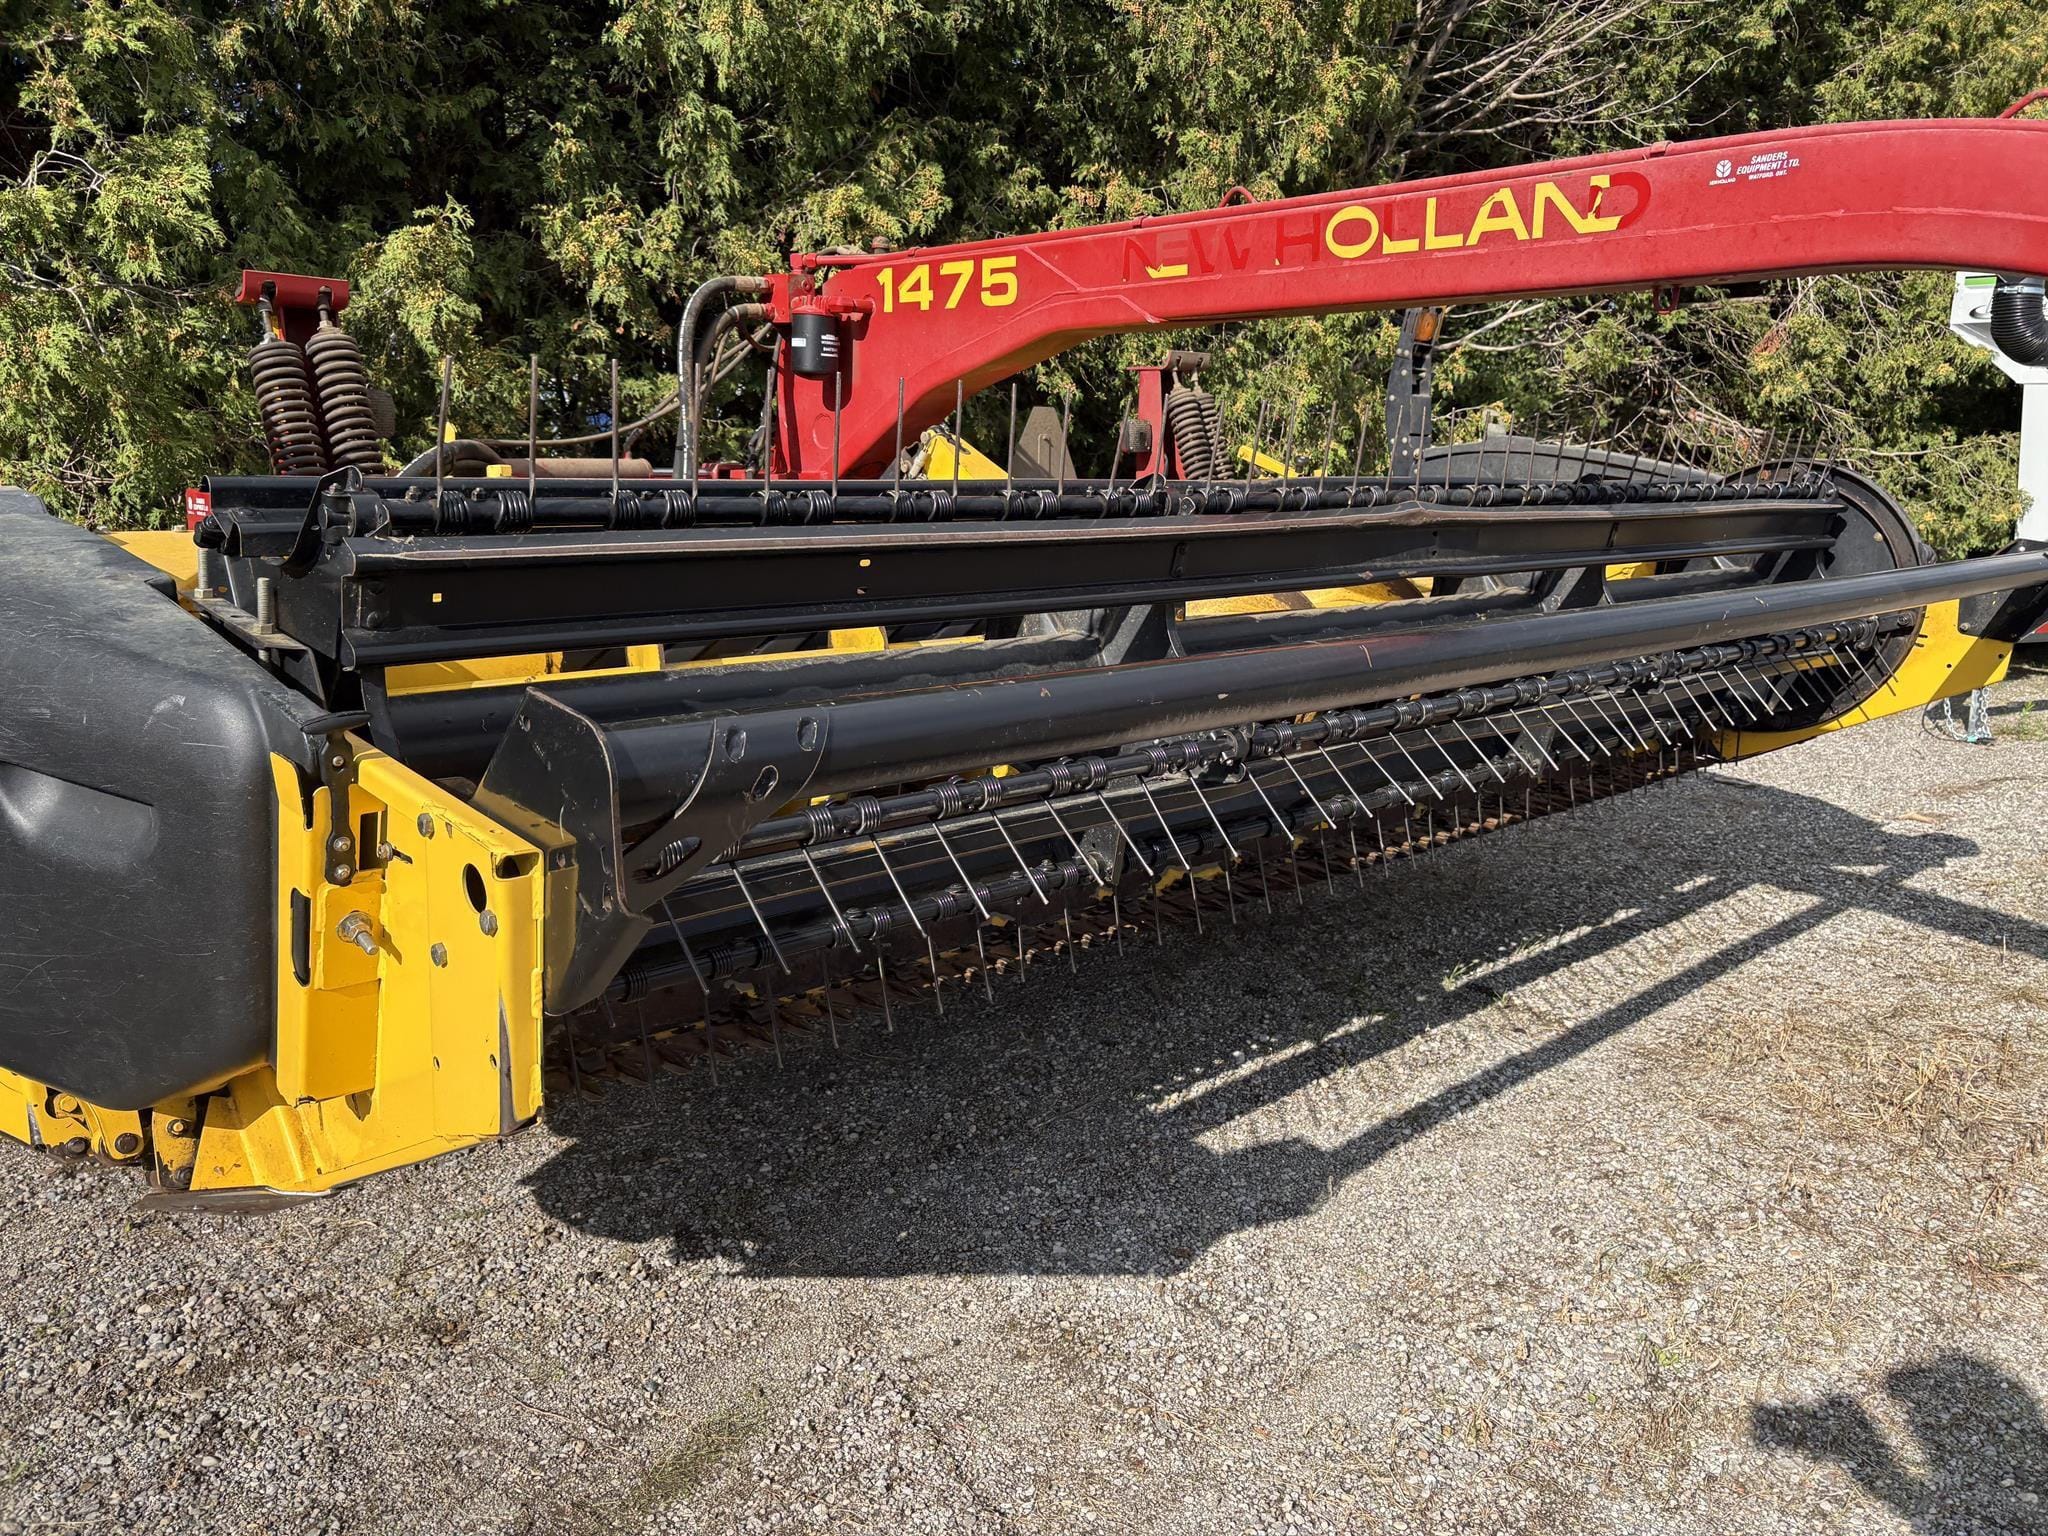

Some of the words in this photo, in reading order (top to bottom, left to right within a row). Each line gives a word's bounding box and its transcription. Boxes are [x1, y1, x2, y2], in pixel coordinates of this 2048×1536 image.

[1736, 161, 1782, 175] EQUIPMENT
[1751, 151, 1788, 164] SANDERS
[1275, 171, 1651, 265] HOLLAND
[876, 256, 1018, 312] 1475
